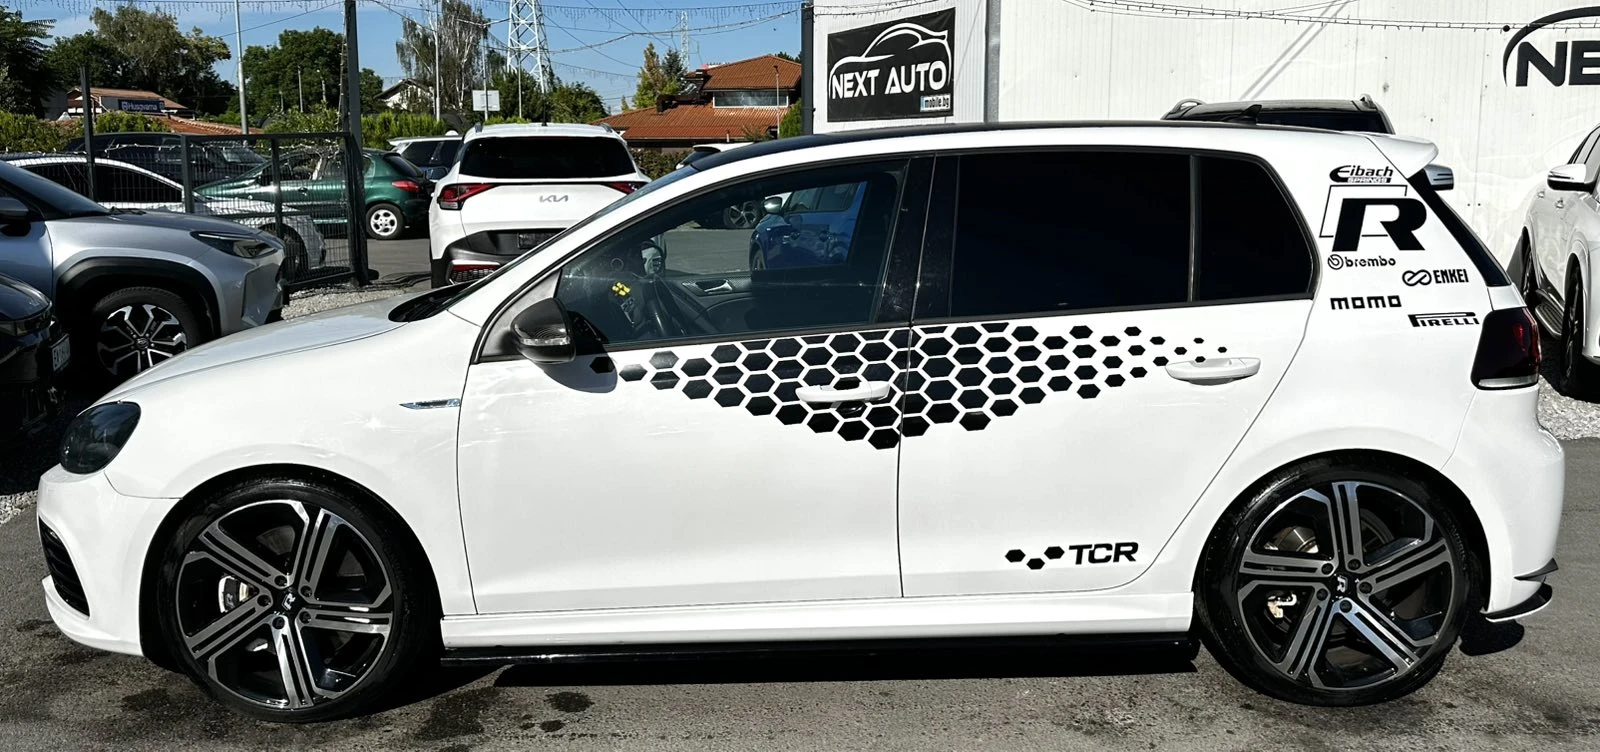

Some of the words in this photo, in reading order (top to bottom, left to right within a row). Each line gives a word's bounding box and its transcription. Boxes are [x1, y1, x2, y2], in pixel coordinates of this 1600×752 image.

[832, 69, 880, 99] NEXT
[885, 60, 947, 95] AUTO
[128, 101, 158, 111] Husqvarna
[925, 97, 950, 109] mobile.bg
[1329, 165, 1394, 183] Eibach
[1332, 198, 1427, 252] R
[1345, 255, 1396, 268] brembo
[1433, 269, 1469, 284] ENKEI
[1407, 312, 1480, 327] PIRELLI
[1068, 542, 1139, 565] TCR
